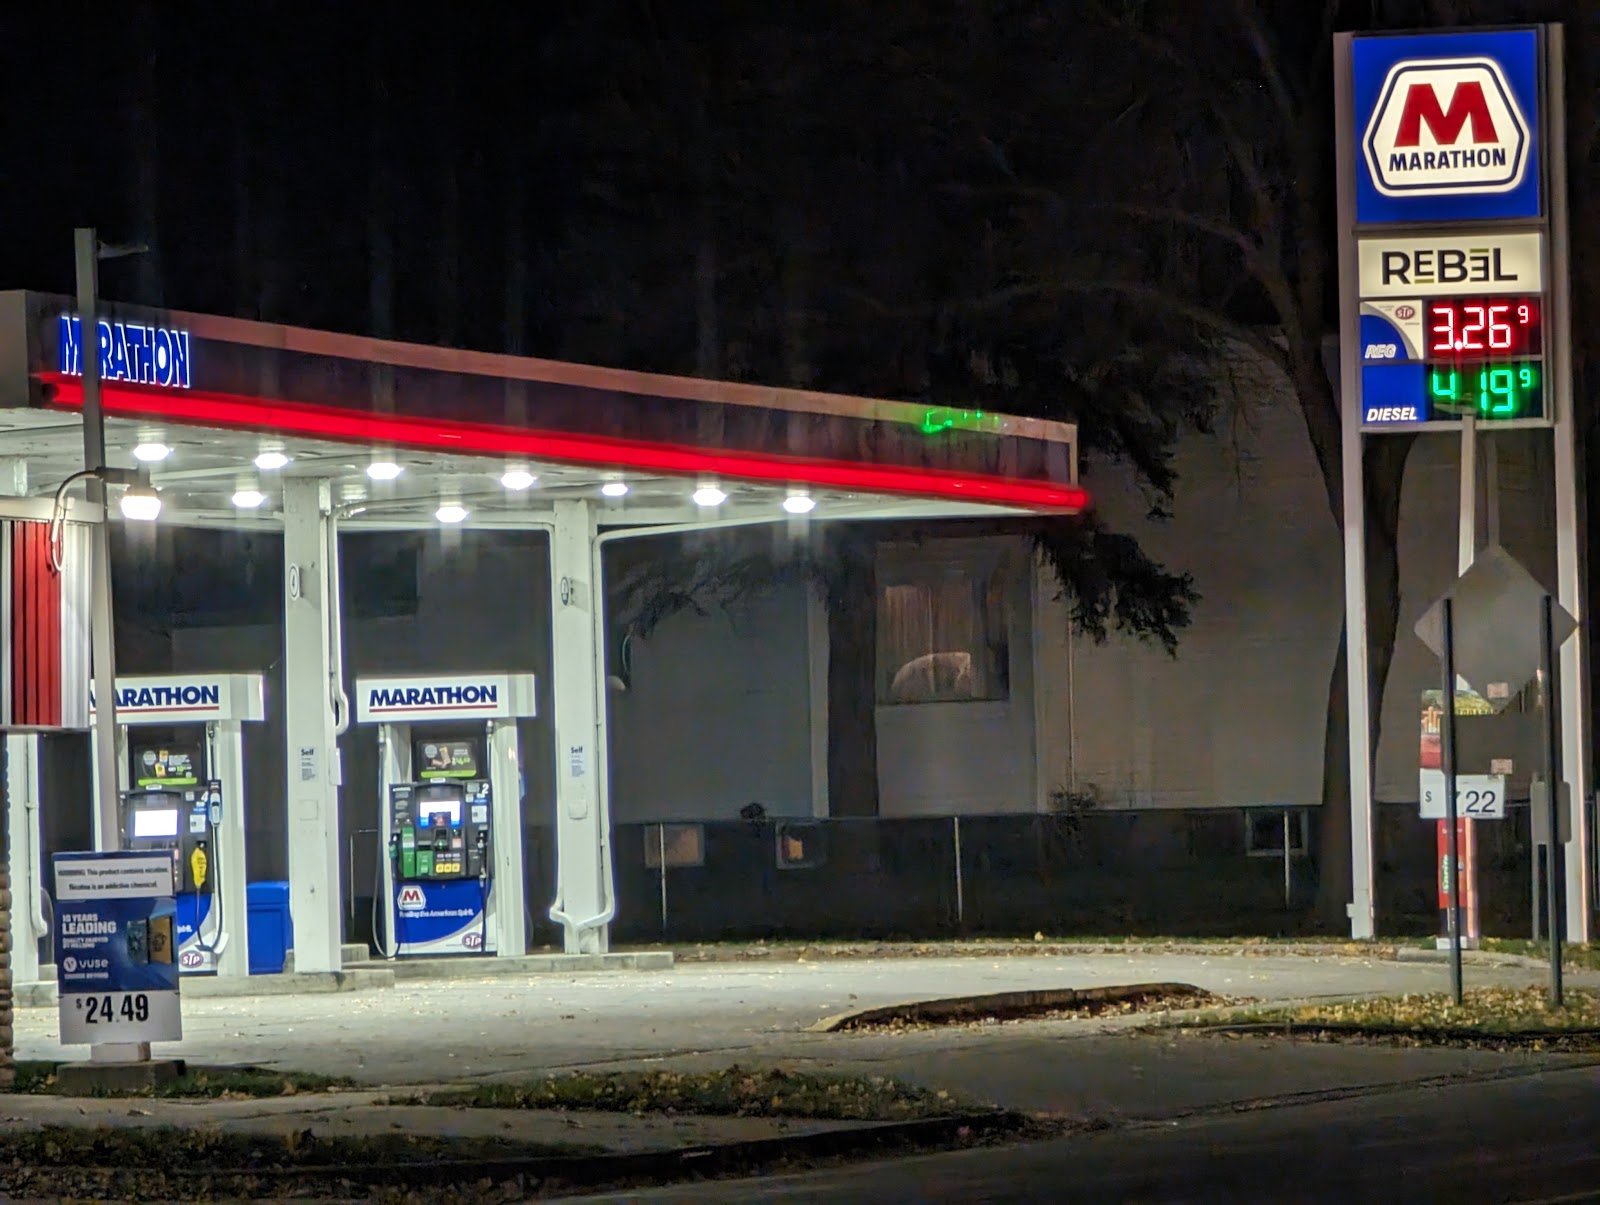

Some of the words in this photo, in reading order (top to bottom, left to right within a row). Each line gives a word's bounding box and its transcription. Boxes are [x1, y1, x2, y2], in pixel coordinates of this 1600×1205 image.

[1394, 81, 1499, 148] M
[1389, 148, 1506, 172] MARATHON
[1382, 248, 1518, 285] REBEL
[1397, 306, 1413, 318] STP
[1433, 305, 1511, 350] 3.26
[61, 316, 191, 389] MRATHON
[1365, 344, 1397, 359] REG
[1366, 406, 1418, 422] DIESEL
[369, 685, 497, 707] MARATHON
[301, 748, 315, 757] Self
[570, 746, 584, 755] Self
[481, 782, 490, 795] 2
[1455, 790, 1496, 816] .22
[62, 921, 117, 935] LEADING
[465, 935, 482, 947] STP
[183, 953, 200, 966] STP
